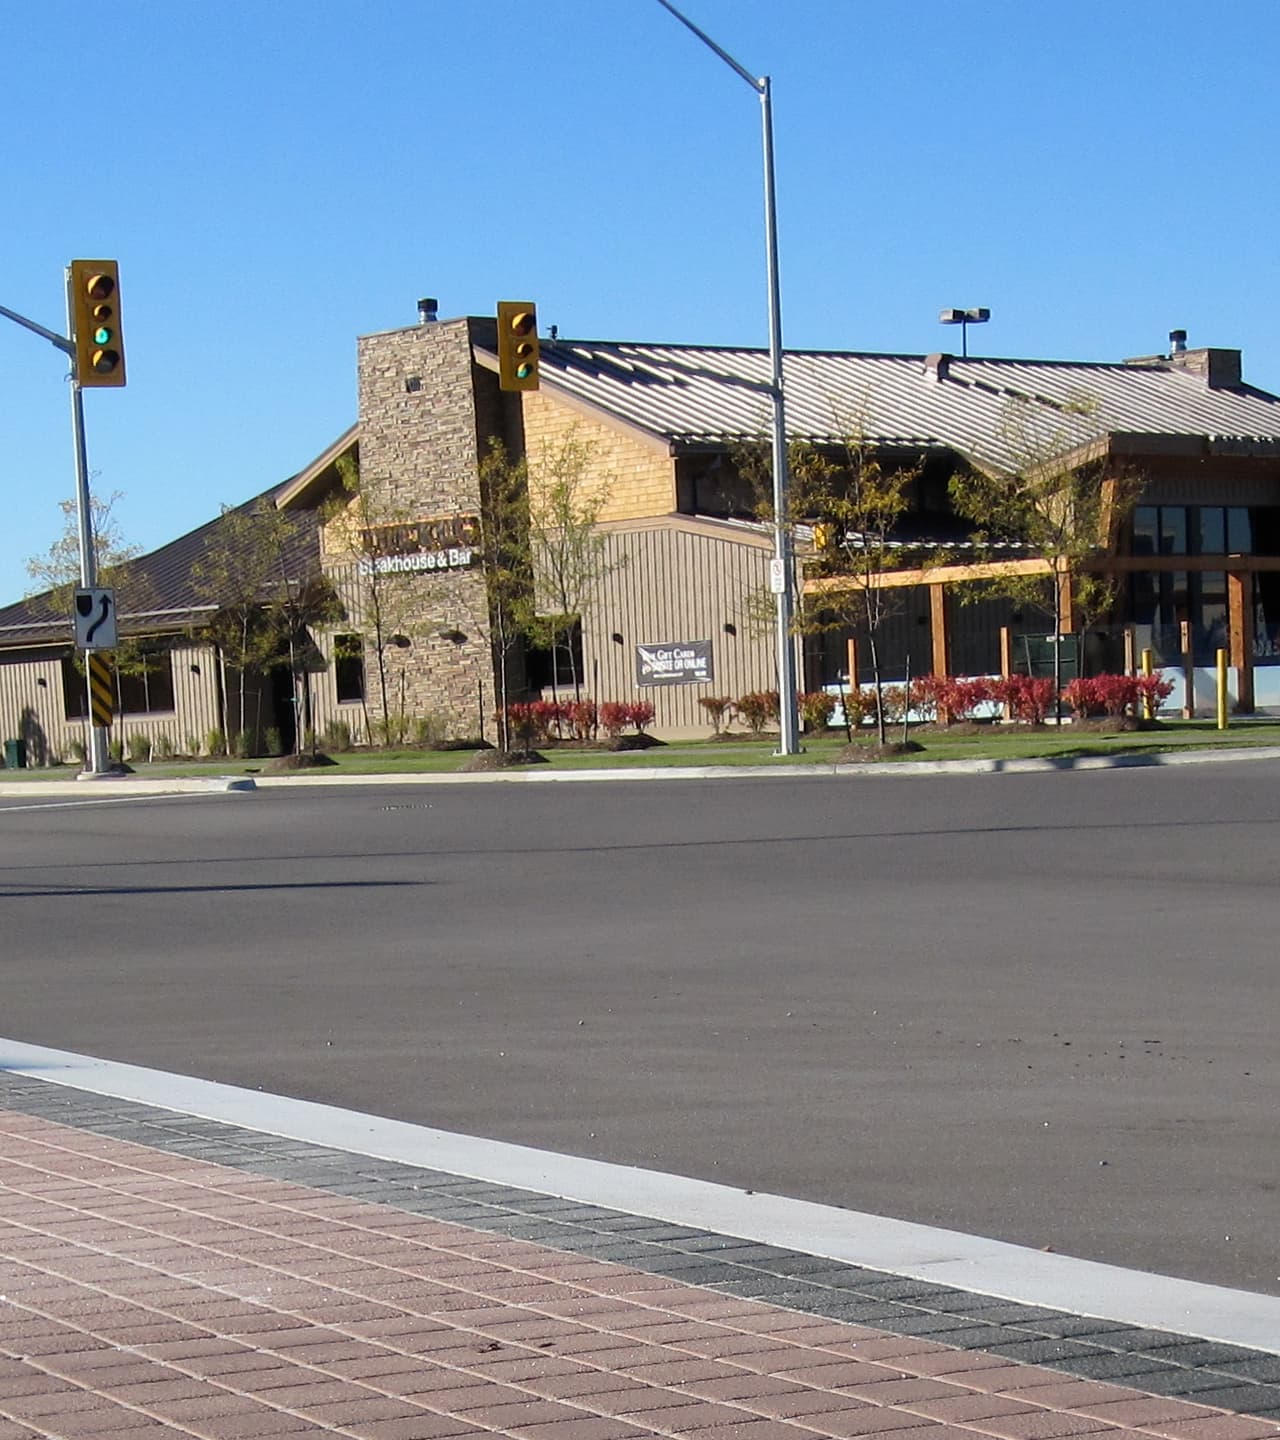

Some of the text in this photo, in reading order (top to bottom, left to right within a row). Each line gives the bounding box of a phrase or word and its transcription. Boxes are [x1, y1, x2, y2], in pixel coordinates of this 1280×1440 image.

[360, 548, 473, 576] Steakhouse & Bar
